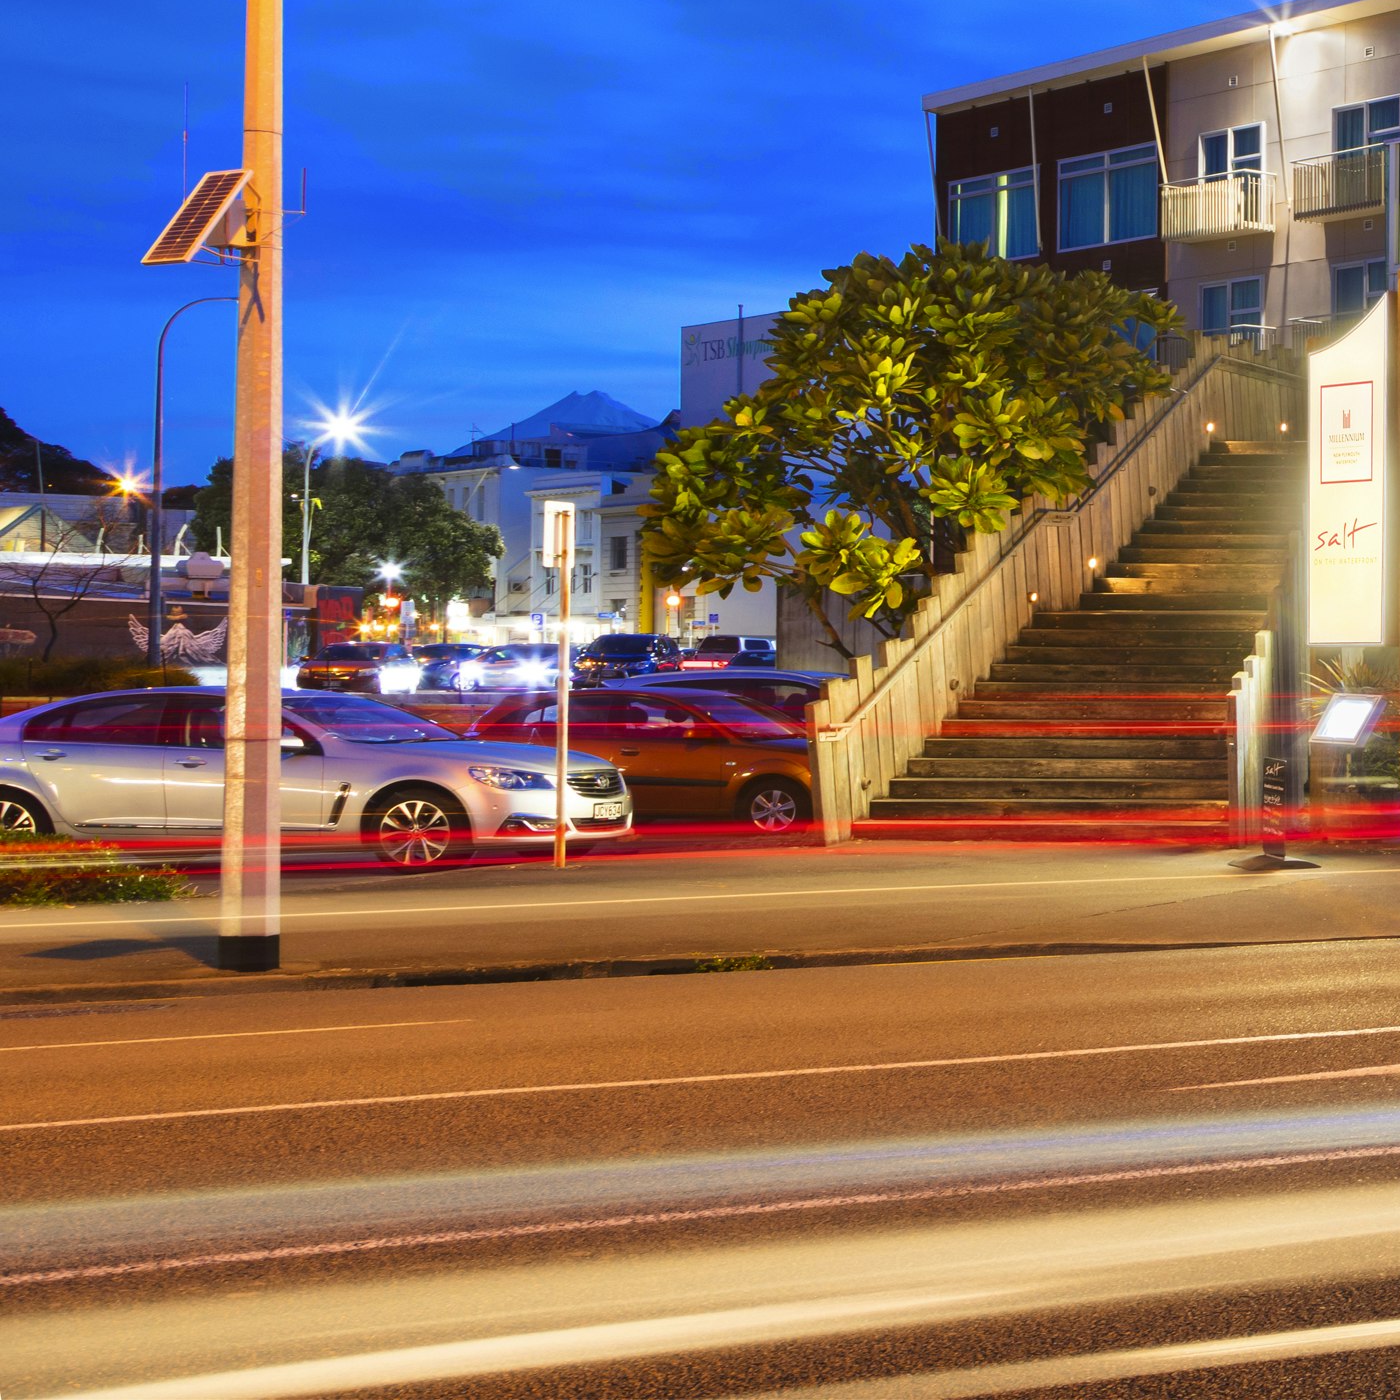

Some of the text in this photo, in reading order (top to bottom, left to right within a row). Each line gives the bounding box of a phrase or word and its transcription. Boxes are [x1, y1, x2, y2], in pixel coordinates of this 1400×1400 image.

[702, 339, 726, 361] TSB
[1328, 433, 1365, 444] MILLENNIUM
[1314, 517, 1378, 552] salt
[1313, 556, 1377, 566] ON THE WATERFRONT
[1265, 762, 1285, 777] salt
[595, 805, 621, 817] JCY634
